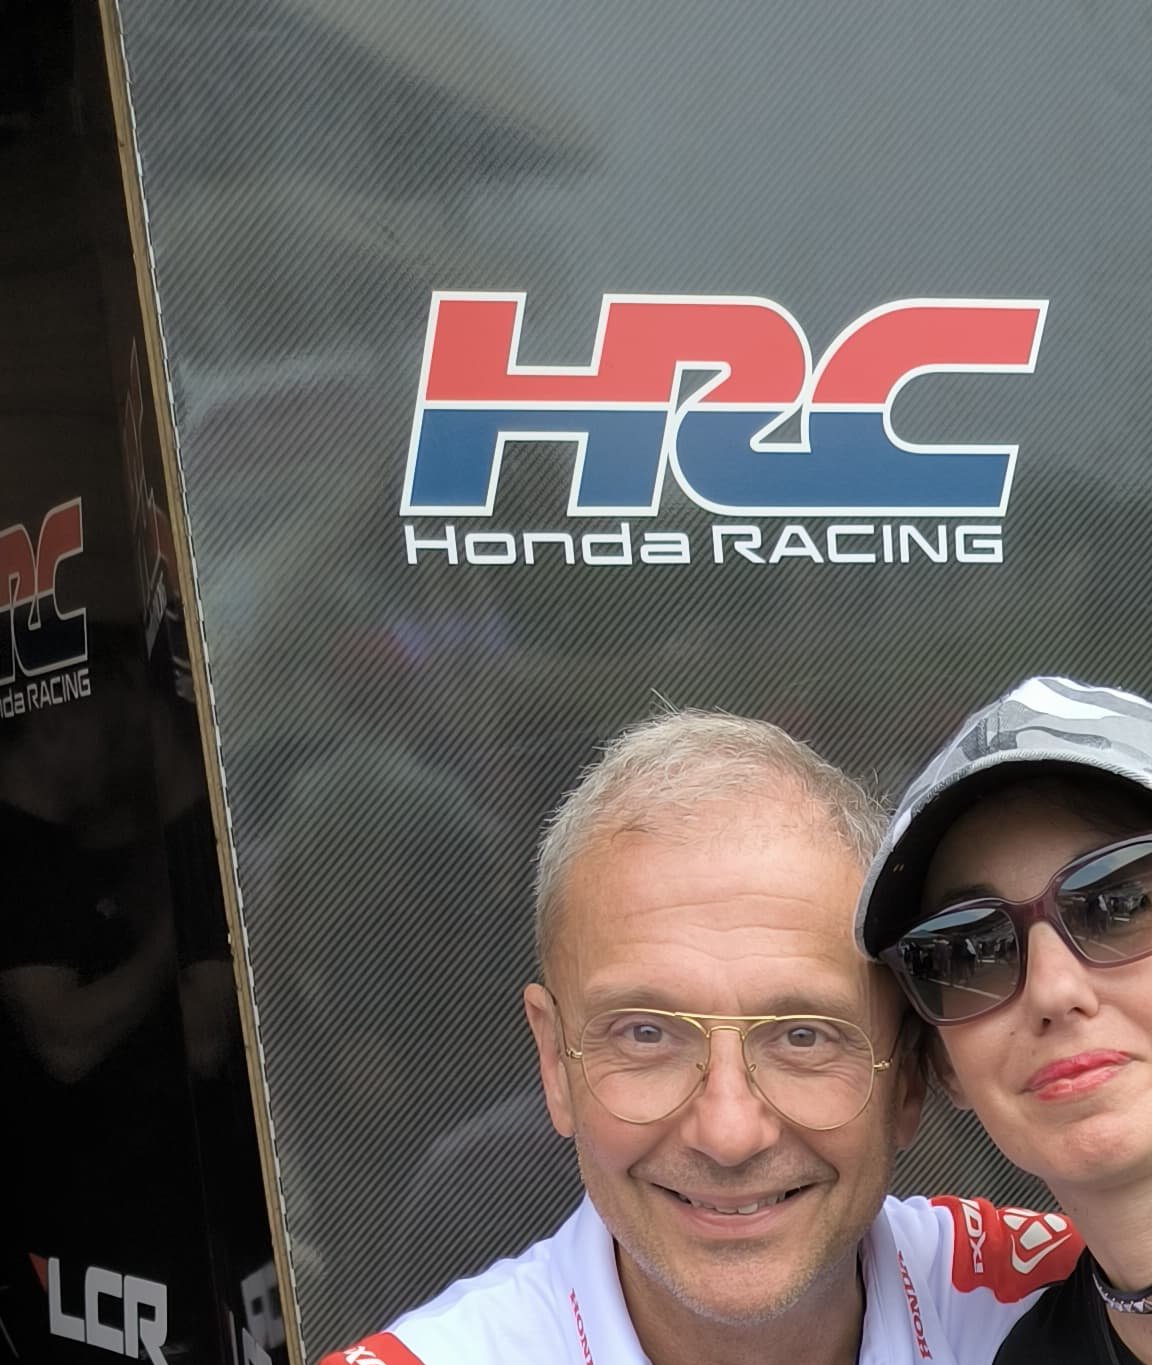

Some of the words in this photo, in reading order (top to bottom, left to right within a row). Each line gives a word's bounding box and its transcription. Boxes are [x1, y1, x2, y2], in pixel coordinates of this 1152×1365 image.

[400, 291, 1049, 516] HRC
[0, 496, 88, 687] RC
[404, 522, 691, 566] Honda
[711, 524, 1004, 566] RACING
[28, 669, 91, 711] RACING
